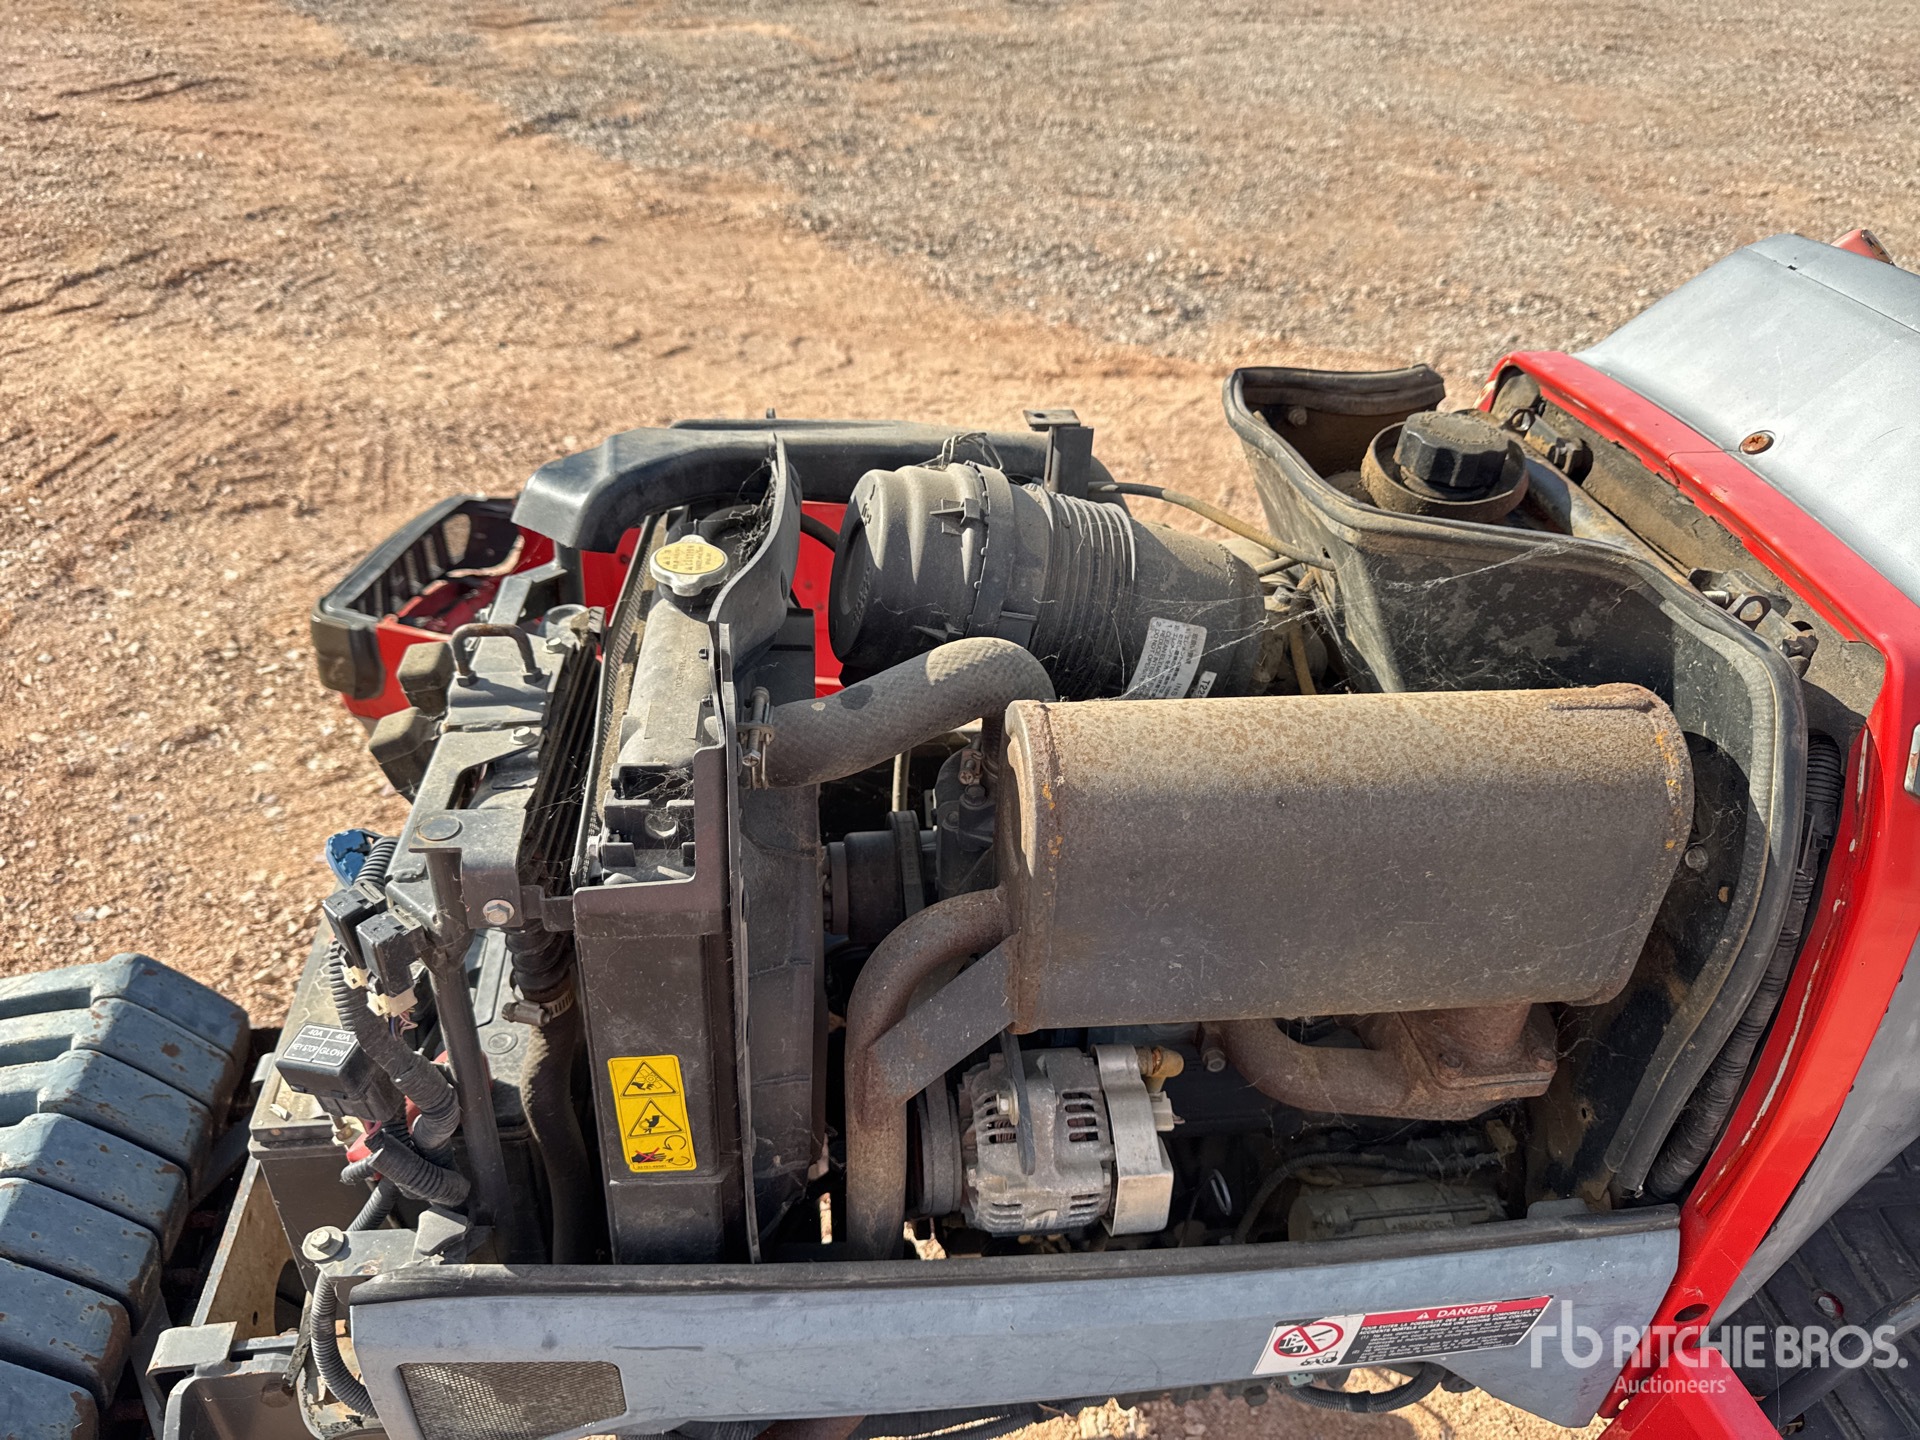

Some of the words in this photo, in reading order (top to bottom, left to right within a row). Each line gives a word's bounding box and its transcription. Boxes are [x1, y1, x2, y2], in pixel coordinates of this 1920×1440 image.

[308, 1029, 324, 1037] 40A
[335, 1033, 351, 1042] 40A
[319, 1047, 346, 1057] GLOW
[1436, 1304, 1498, 1318] DANGER
